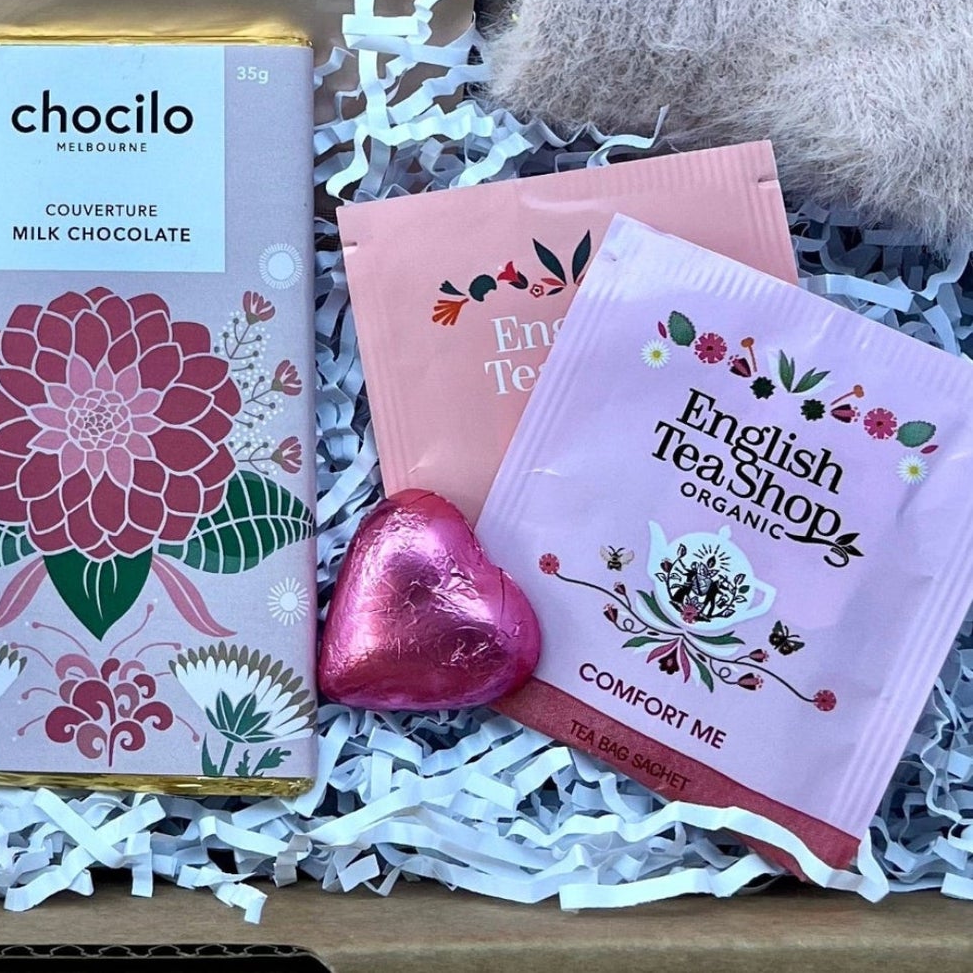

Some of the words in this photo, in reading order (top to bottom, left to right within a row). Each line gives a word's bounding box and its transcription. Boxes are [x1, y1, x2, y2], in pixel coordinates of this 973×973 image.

[236, 67, 269, 84] 35g
[11, 90, 194, 135] chocilo
[56, 142, 148, 153] MELBOURNE
[45, 203, 158, 218] COUVERTURE
[12, 225, 60, 241] MILK
[67, 226, 191, 243] CHOCOLATE
[484, 359, 543, 395] Te
[676, 388, 844, 494] English
[651, 421, 725, 486] Tea
[727, 461, 842, 540] Shop
[680, 482, 785, 540] ORGANIC
[579, 662, 689, 729] COMFORT
[689, 719, 726, 749] ME
[570, 719, 594, 746] TEA
[598, 736, 629, 761] BAG
[631, 753, 691, 791] SACHET
